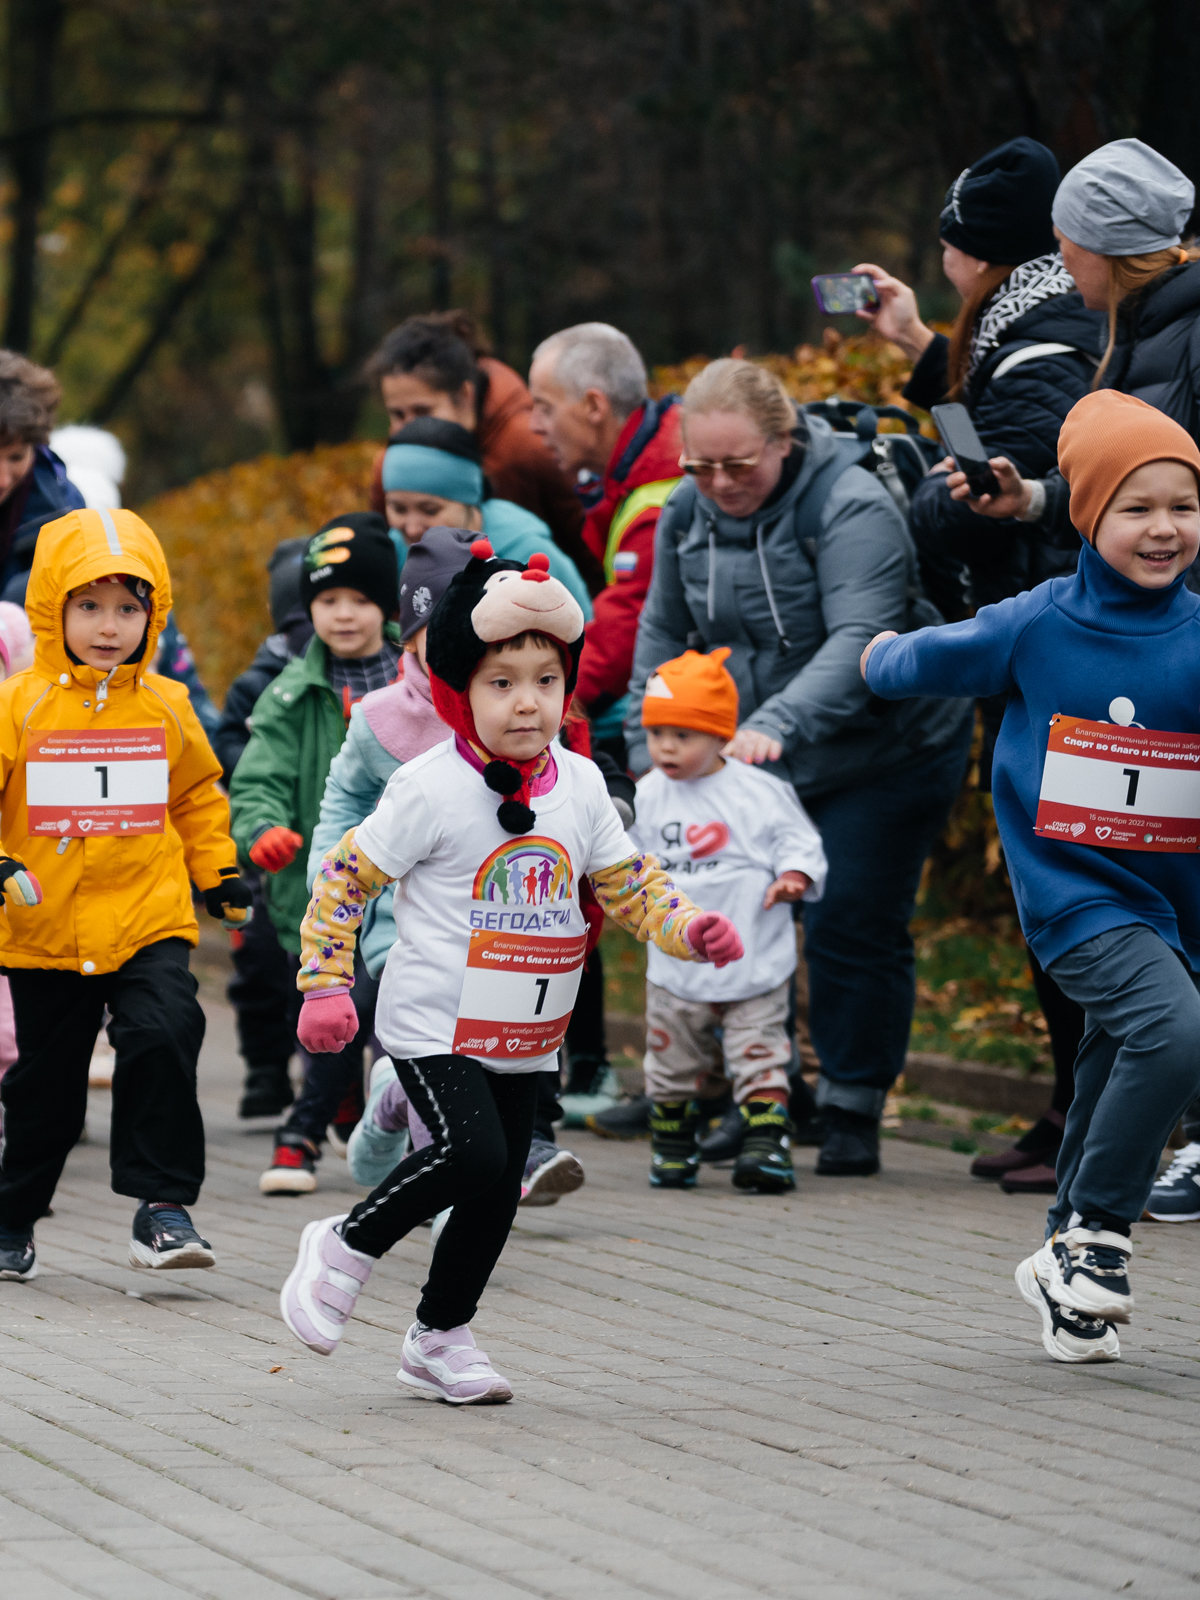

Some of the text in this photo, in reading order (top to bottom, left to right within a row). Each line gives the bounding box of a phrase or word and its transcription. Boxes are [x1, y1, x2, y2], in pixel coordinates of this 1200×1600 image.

[1074, 727, 1148, 746] Благотворительный
[1149, 739, 1181, 749] осенний
[38, 746, 66, 755] Спорт
[80, 746, 105, 754] благо
[114, 744, 162, 754] KasperskyOS
[1063, 736, 1200, 763] Спорт во благо и Kaspersky
[93, 766, 108, 798] 1
[1122, 768, 1141, 806] 1
[1052, 820, 1070, 829] СПОРТ
[1089, 813, 1162, 828] 15 октября 2022 года
[660, 821, 681, 849] Я
[1112, 829, 1137, 837] Синдром
[1155, 835, 1197, 844] KasperskyOS
[469, 908, 571, 932] БЕГОДЕТИ
[493, 941, 560, 953] Благотворительный
[481, 950, 512, 962] Спорт
[513, 955, 525, 963] во
[526, 955, 552, 965] благо
[534, 978, 550, 1015] 1
[509, 1027, 533, 1035] октября
